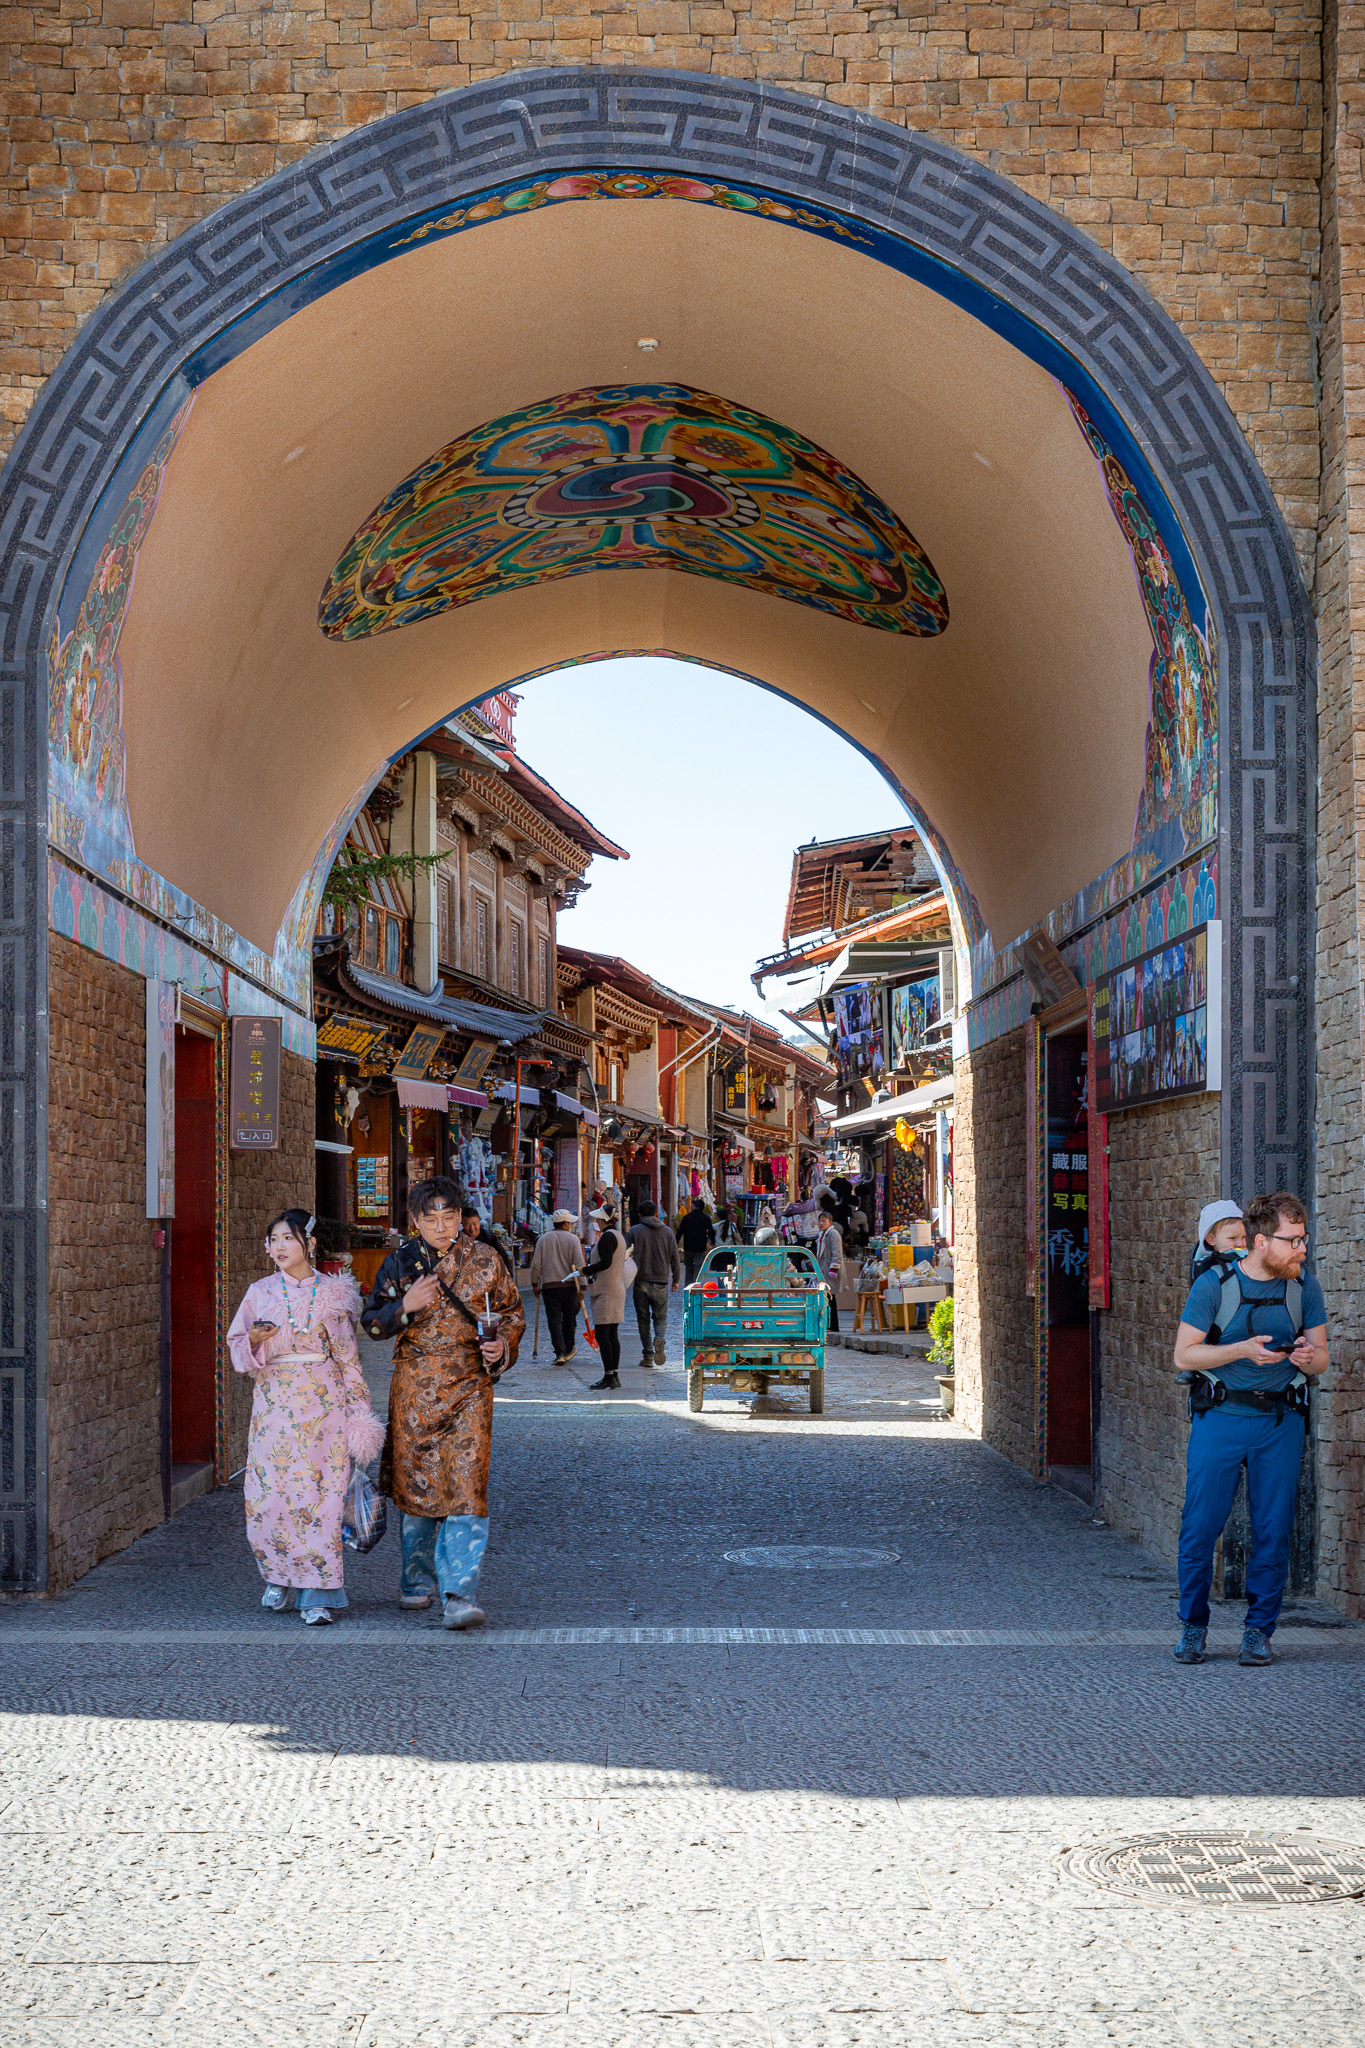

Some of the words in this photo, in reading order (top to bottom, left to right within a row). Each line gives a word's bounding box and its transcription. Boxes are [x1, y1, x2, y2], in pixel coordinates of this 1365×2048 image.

[735, 1073, 746, 1094] 锅语
[252, 1131, 270, 1140] 入口
[1052, 1153, 1088, 1171] 藏服
[1052, 1173, 1088, 1191] 彝服
[1053, 1193, 1088, 1211] 写真
